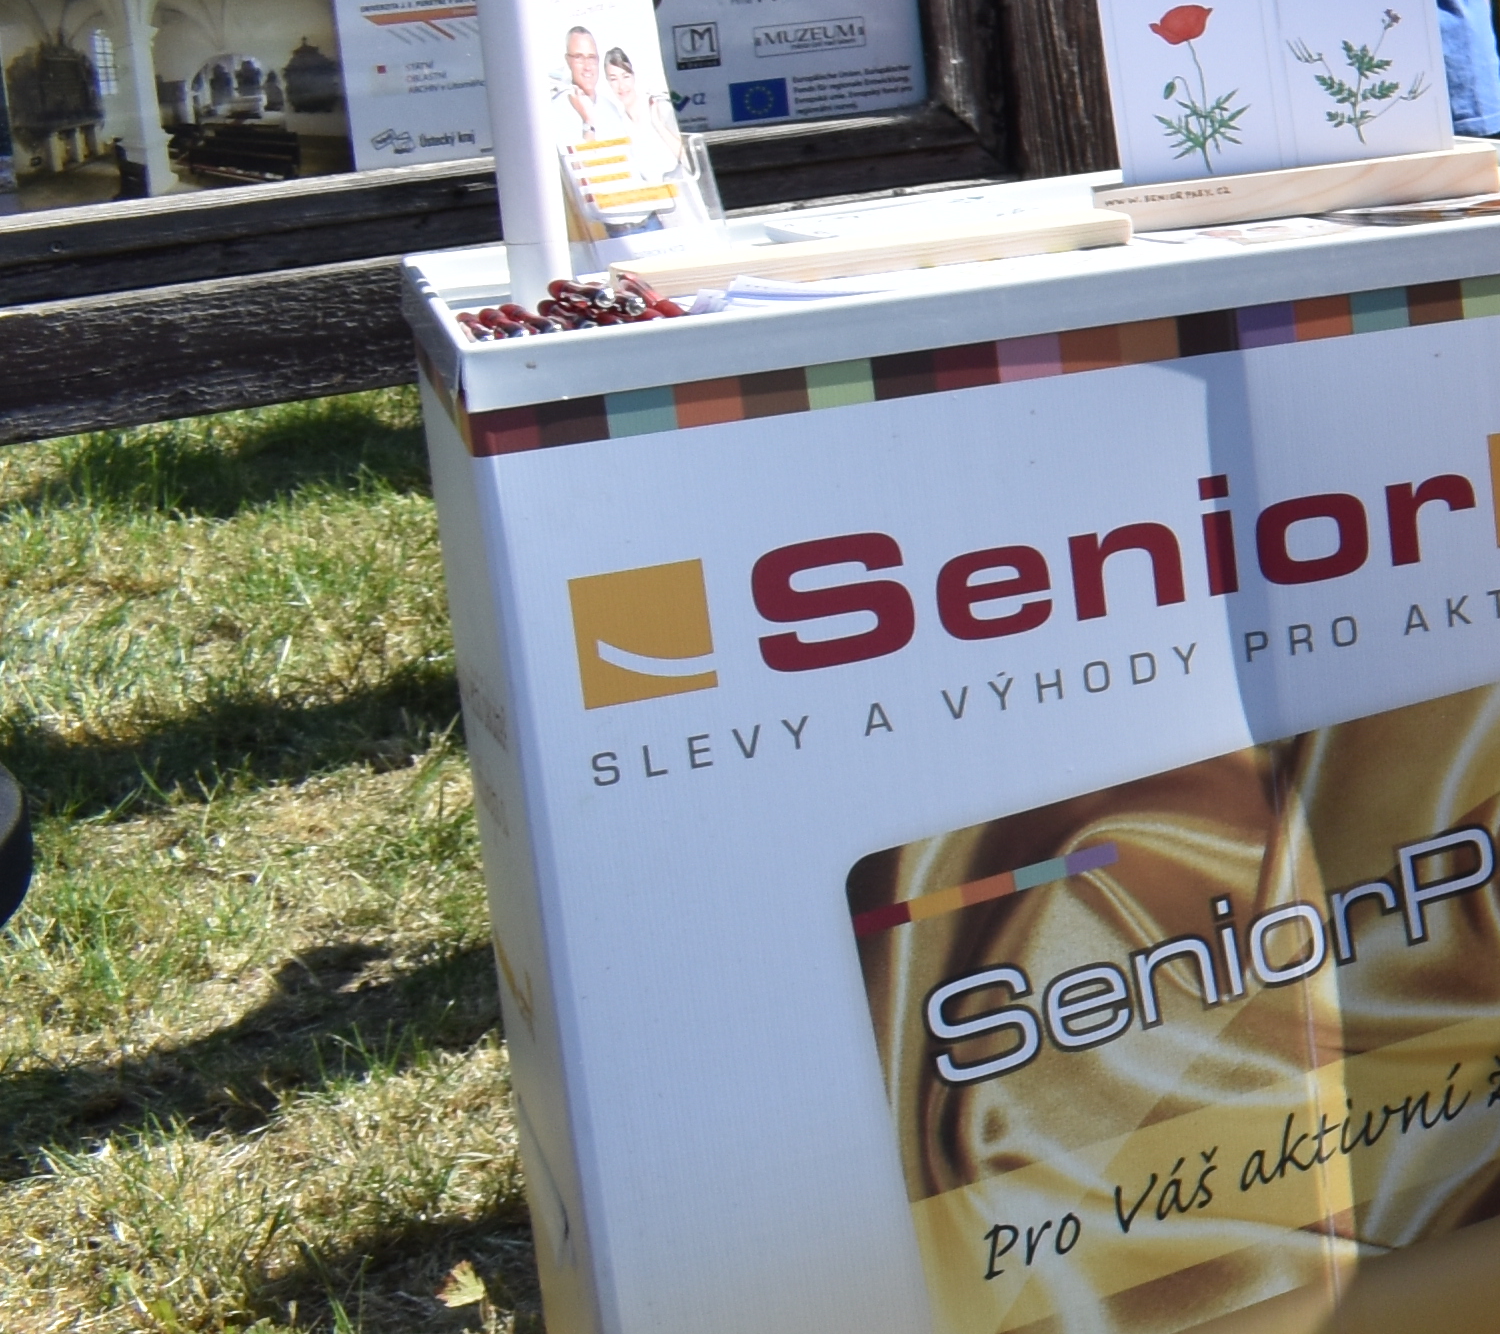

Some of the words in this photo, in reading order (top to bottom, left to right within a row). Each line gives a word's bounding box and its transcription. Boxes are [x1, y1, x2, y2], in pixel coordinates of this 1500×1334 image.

[764, 23, 856, 45] MUZEUM
[591, 715, 810, 786] SLEVY
[864, 702, 893, 737] A
[941, 641, 1198, 722] VÝHODY
[1244, 615, 1359, 663] PRO
[983, 1212, 1082, 1281] Pro
[1114, 1145, 1216, 1234] Váš
[1238, 1062, 1472, 1194] aktivní
